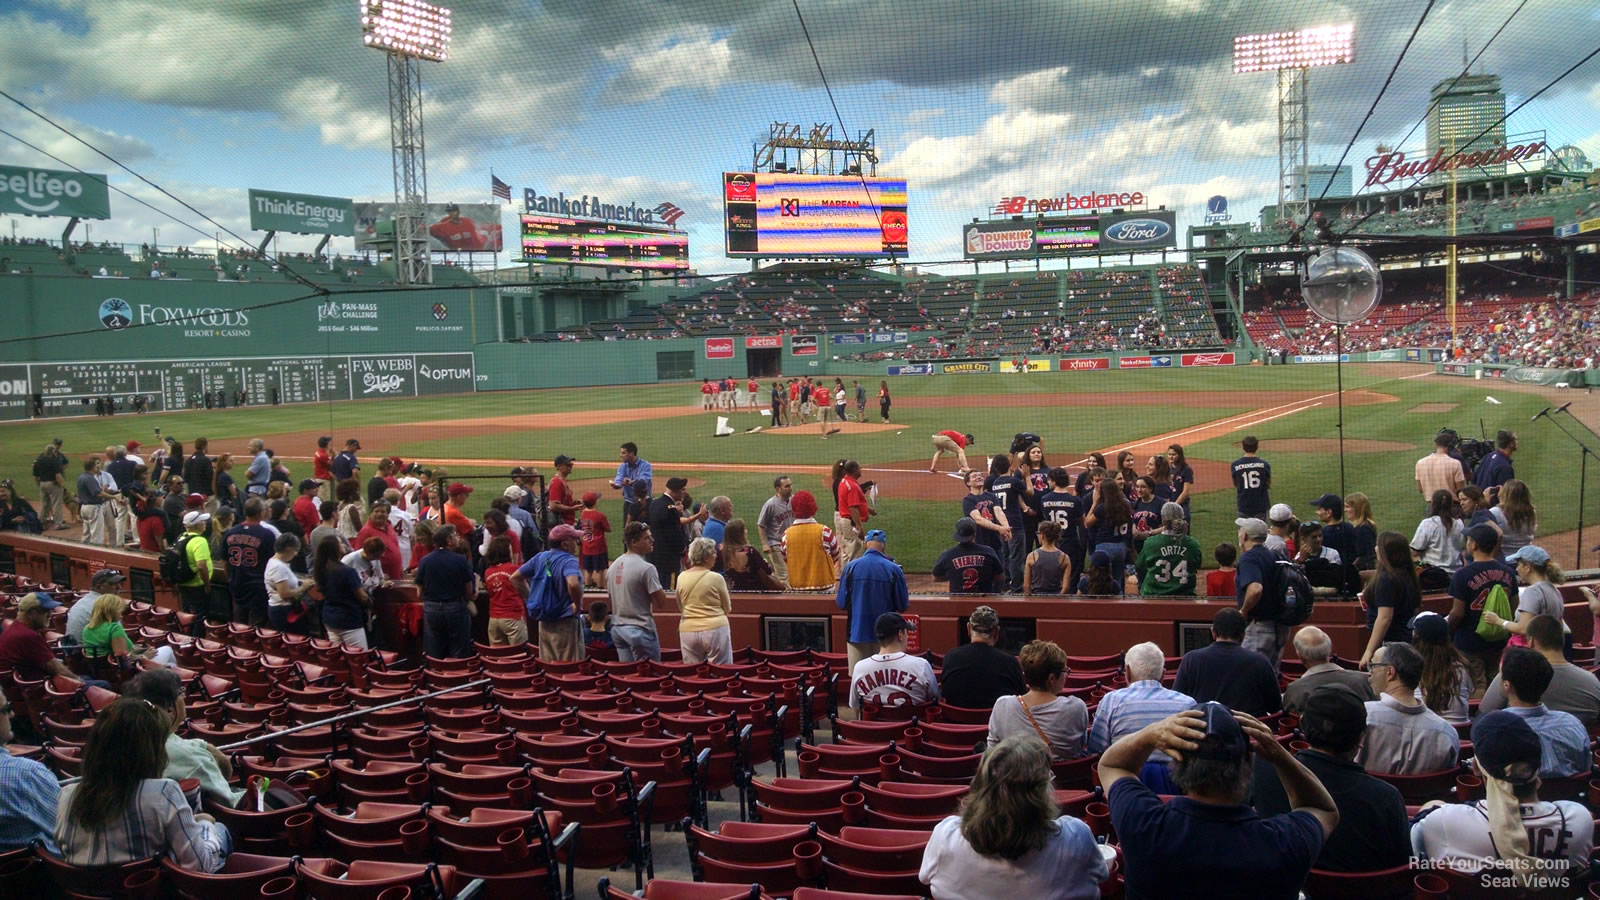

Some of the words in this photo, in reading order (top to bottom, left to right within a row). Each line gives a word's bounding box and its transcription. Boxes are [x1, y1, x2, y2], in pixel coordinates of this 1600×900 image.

[806, 122, 878, 163] Hancock
[1365, 140, 1546, 187] Budweiser
[254, 197, 346, 222] ThinkEnergy
[524, 187, 569, 214] Bank
[572, 195, 588, 216] of
[591, 197, 653, 224] America
[1028, 198, 1064, 213] new
[1066, 191, 1144, 210] balance
[360, 217, 377, 225] MY
[985, 228, 1033, 241] DUNKIN'
[1117, 223, 1157, 240] Ford
[985, 239, 1030, 251] DONUTS
[138, 304, 249, 326] FOXWOODS
[342, 303, 377, 311] PAN-MASS
[342, 311, 378, 319] CHALLENGE
[751, 338, 777, 346] aetna
[377, 359, 413, 371] WEBB
[944, 363, 973, 373] GRANITE
[974, 363, 989, 371] CITY
[1070, 361, 1098, 370] xfinity
[432, 368, 471, 380] OPTUM
[1241, 470, 1261, 489] 16
[1048, 509, 1069, 530] 16
[1160, 545, 1188, 557] ORTIZ
[952, 555, 985, 570] EVERETT
[962, 568, 979, 591] 2
[1154, 559, 1189, 584] 34
[856, 669, 919, 696] RAMIREZ
